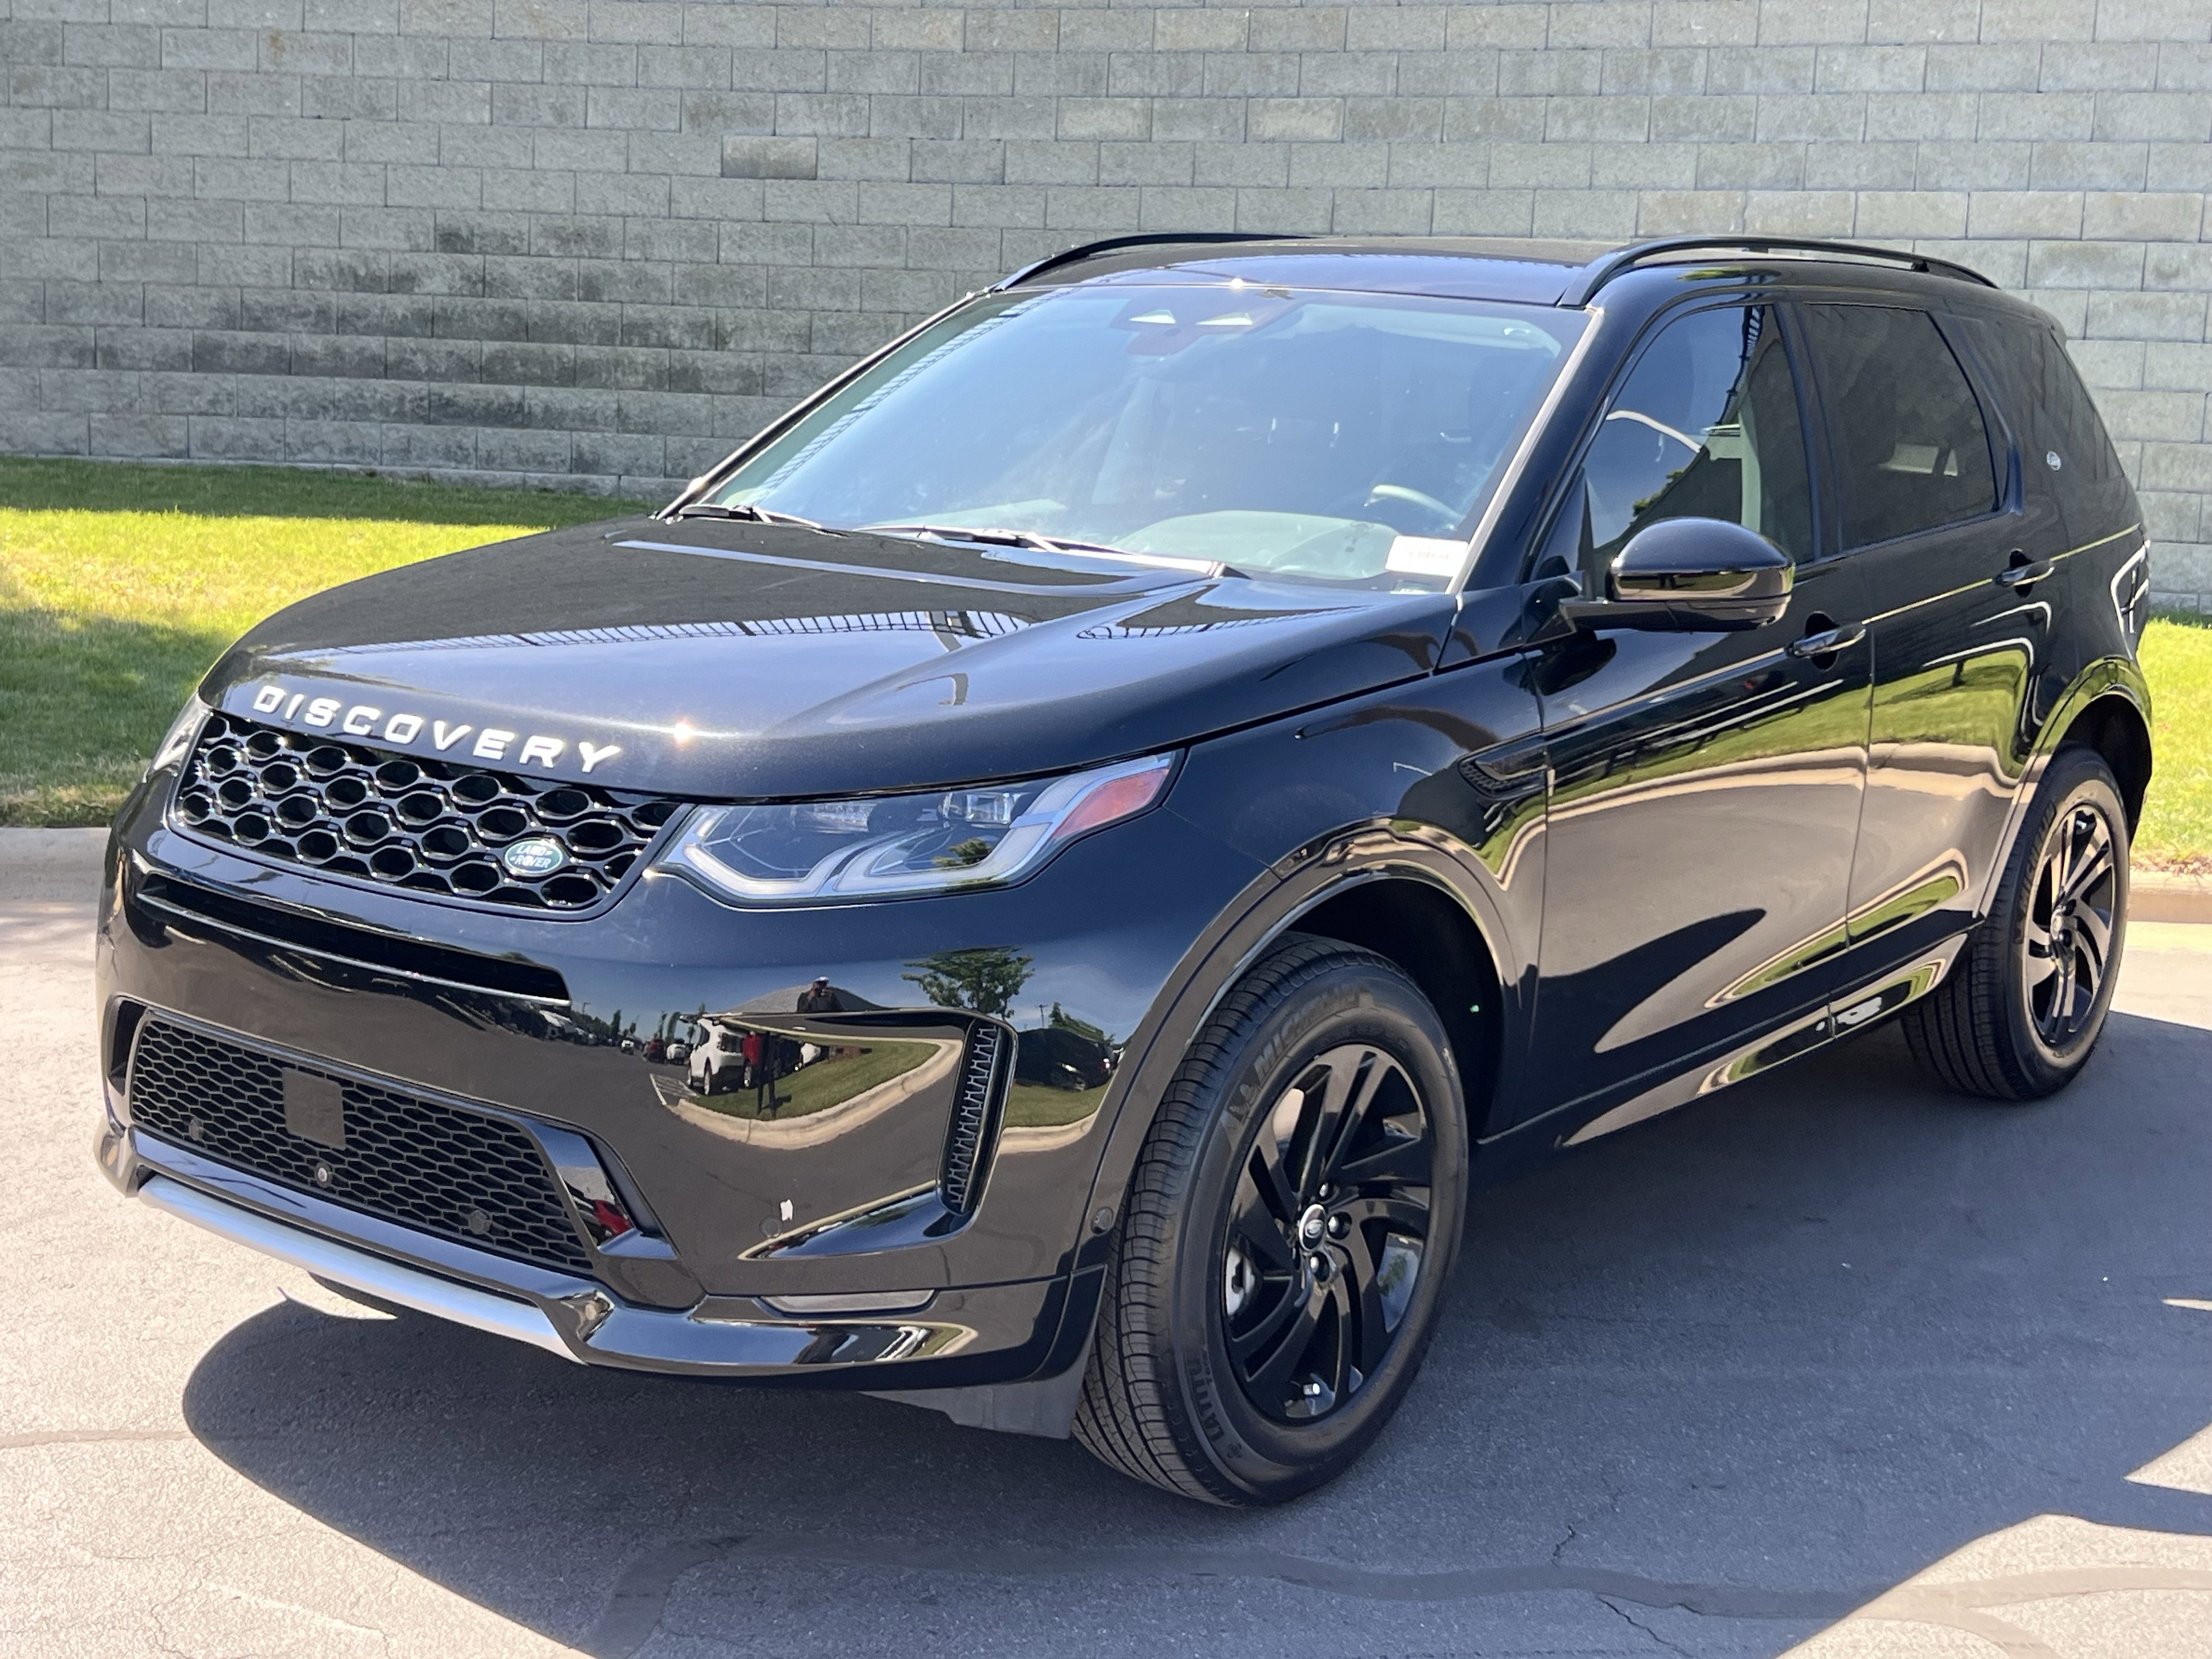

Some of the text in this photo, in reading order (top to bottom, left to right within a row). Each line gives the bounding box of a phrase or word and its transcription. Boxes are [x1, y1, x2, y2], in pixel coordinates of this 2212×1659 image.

[252, 685, 621, 773] DISCOVERY
[516, 845, 548, 856] LAND
[515, 854, 551, 868] ROVER
